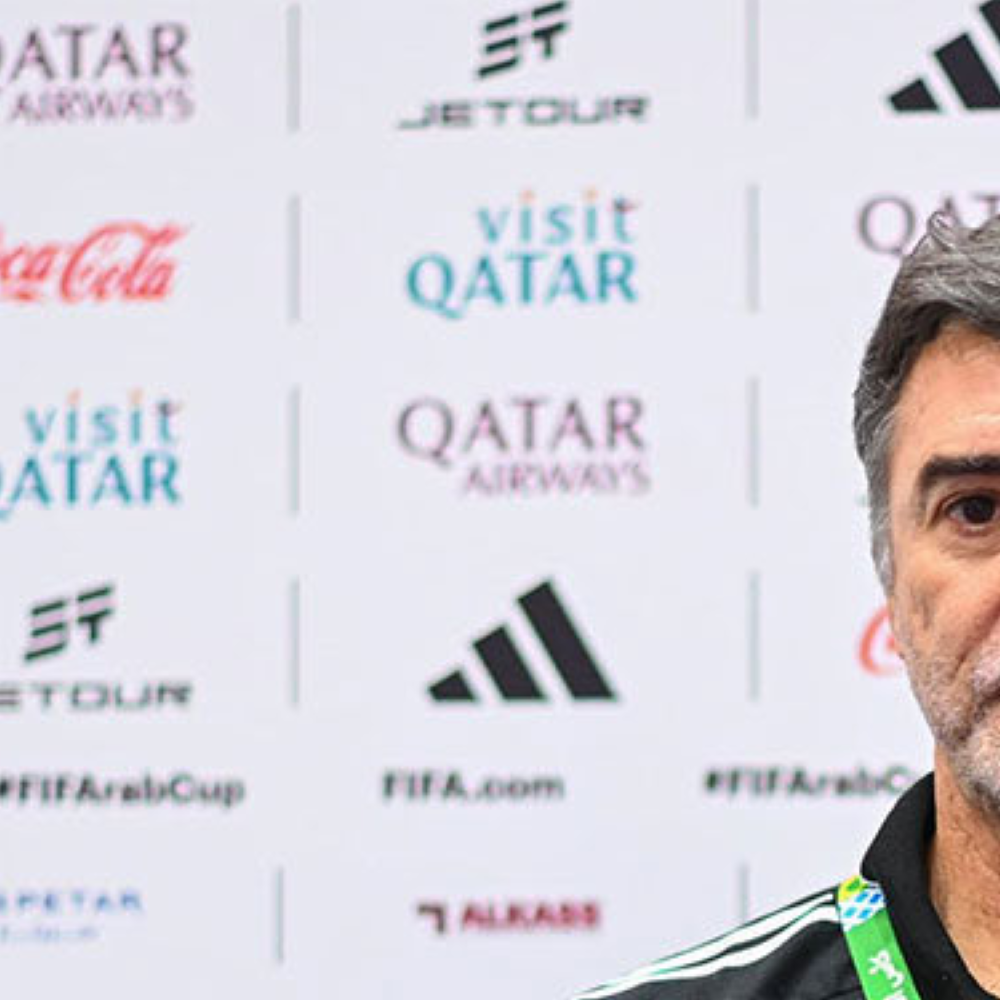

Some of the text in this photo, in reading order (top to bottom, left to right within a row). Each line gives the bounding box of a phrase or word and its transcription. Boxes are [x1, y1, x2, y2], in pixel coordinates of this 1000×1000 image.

[0, 24, 190, 81] ATAR
[11, 87, 194, 121] AIRWAYS
[399, 96, 650, 129] JETOUR
[477, 188, 637, 246] visit
[406, 250, 639, 319] QATAR
[24, 388, 182, 446] visit
[395, 396, 646, 469] QATAR
[0, 452, 181, 520] ATAR
[463, 461, 652, 498] AIRWAYS
[0, 681, 193, 711] ETOUR
[381, 769, 565, 801] FIFA.com
[704, 764, 912, 799] #FIFArabC
